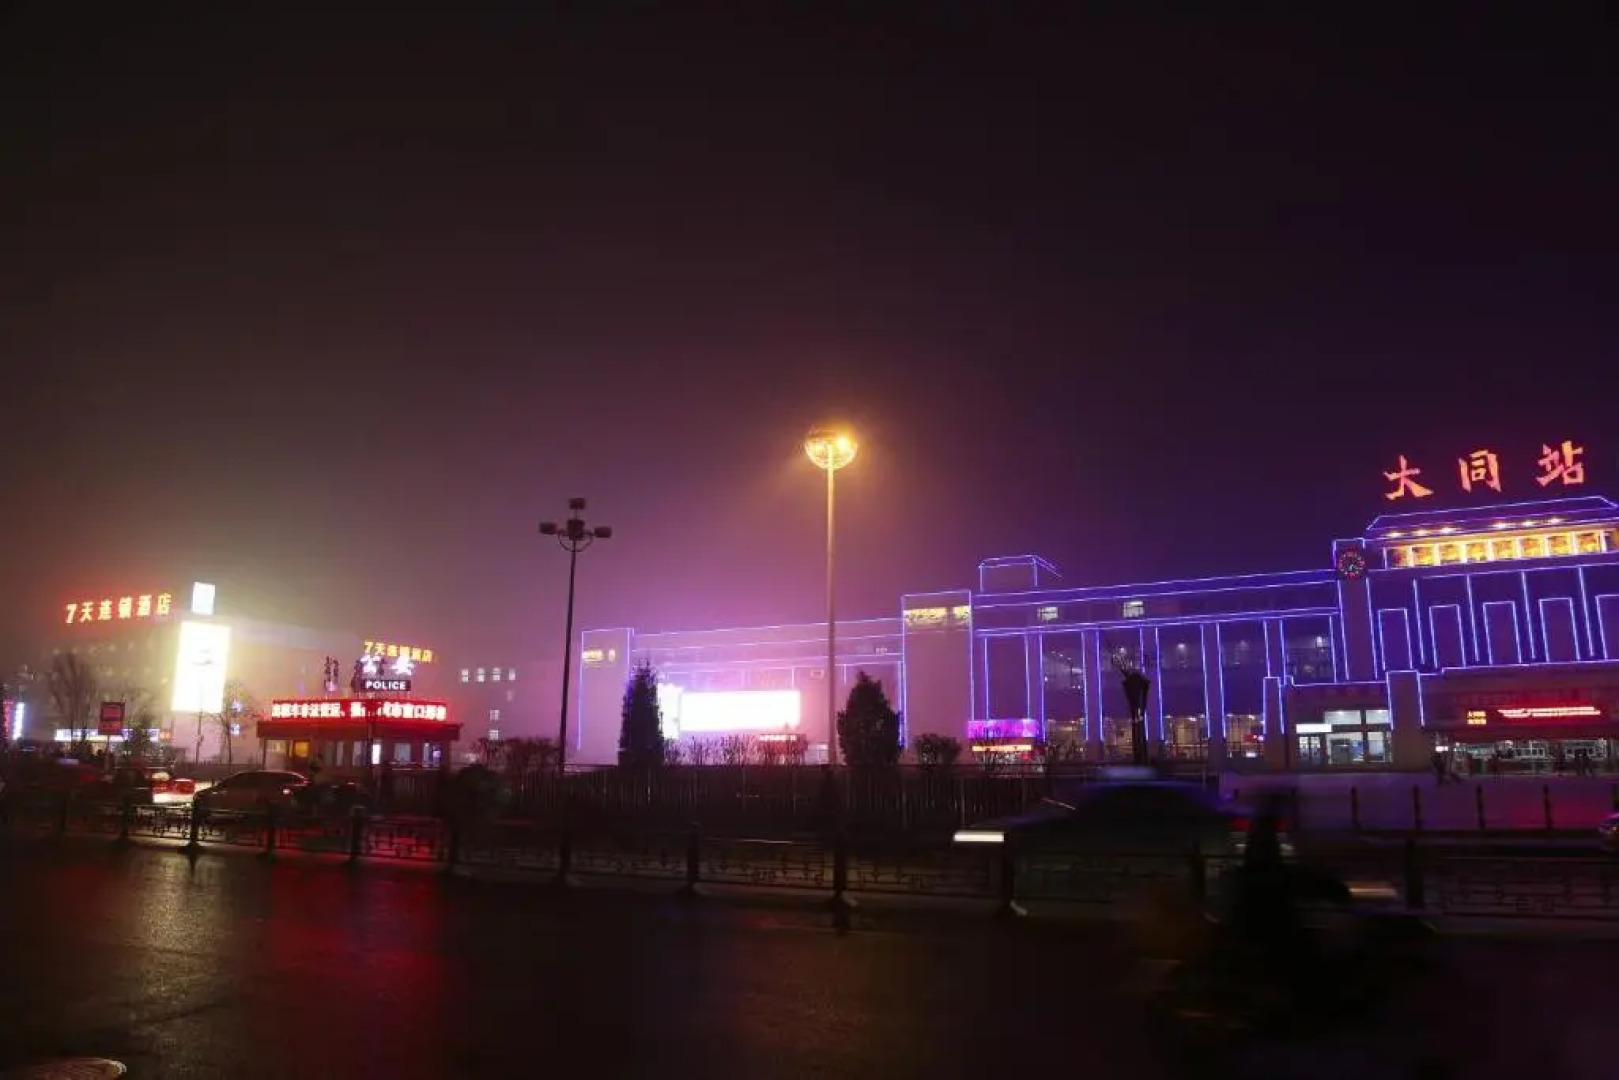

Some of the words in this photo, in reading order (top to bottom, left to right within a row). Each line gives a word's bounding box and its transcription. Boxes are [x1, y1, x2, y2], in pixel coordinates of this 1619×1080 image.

[1383, 440, 1585, 500] 大同站
[366, 680, 406, 690] POLICE
